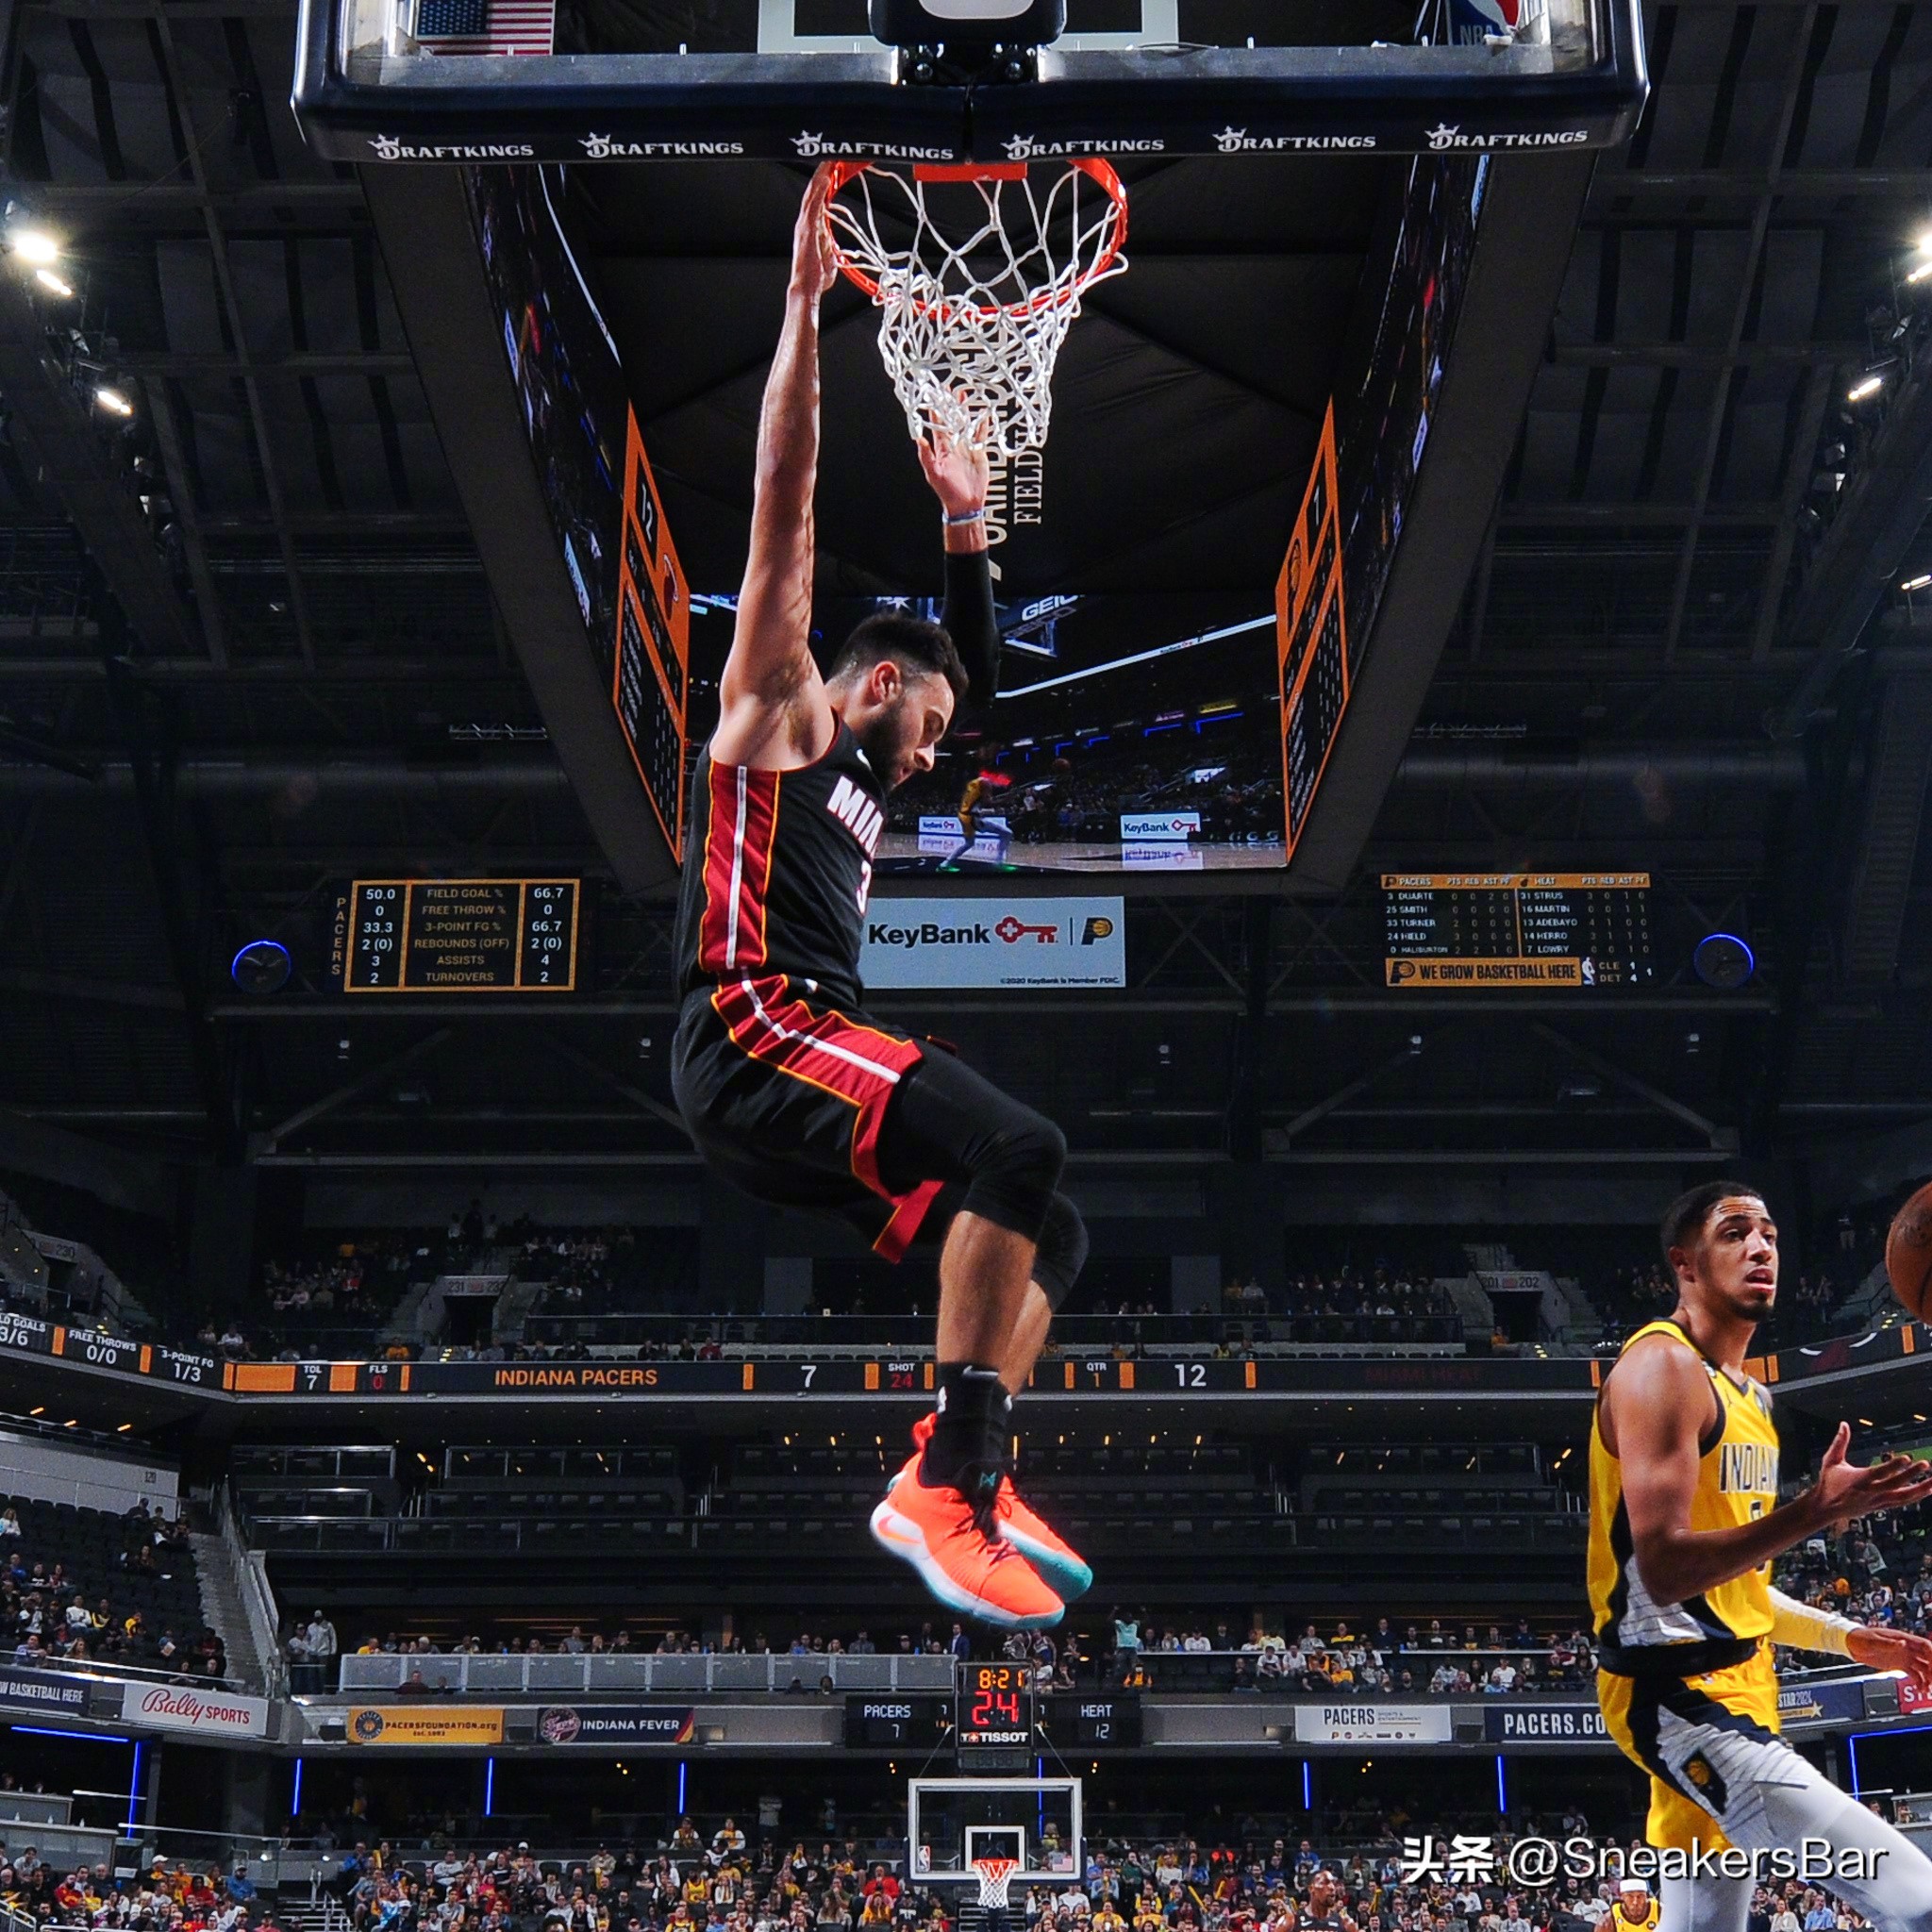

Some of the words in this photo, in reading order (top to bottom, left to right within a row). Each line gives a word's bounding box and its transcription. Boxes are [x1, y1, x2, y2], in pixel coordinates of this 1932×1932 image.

[1217, 134, 1376, 152] DRAFTKINGS
[1429, 130, 1589, 149] DRAFTKINGS
[375, 141, 534, 159] DRAFTKINGS
[586, 141, 744, 158] DRAFTKINGS
[796, 138, 954, 159] DRAFTKINGS
[1007, 139, 1164, 159] DRAFTKINGS
[827, 775, 884, 857] MIA
[1124, 823, 1169, 834] KeyBank
[366, 889, 395, 900] 50.0
[427, 889, 458, 898] FIELD
[461, 888, 491, 898] GOAL
[533, 887, 564, 899] 66.7
[1534, 891, 1563, 900] STRUS
[375, 906, 384, 916] 0
[422, 906, 449, 915] FREE
[453, 905, 495, 915] THROW
[543, 904, 553, 915] 0
[363, 922, 393, 933] 33.3
[425, 922, 471, 932] 3-POINT
[474, 922, 490, 932] FG
[531, 921, 562, 932] 66.7
[868, 924, 991, 948] KeyBank
[361, 940, 372, 951] 2
[374, 939, 393, 952] (0)
[414, 939, 477, 949] REBOUNDS
[479, 938, 509, 950] (OFF)
[530, 939, 541, 949] 2
[543, 938, 562, 951] (0)
[371, 956, 380, 967] 3
[436, 955, 485, 965] ASSISTS
[541, 954, 550, 966] 4
[1599, 961, 1621, 971] CLE
[370, 972, 379, 984] 2
[425, 972, 494, 982] TURNOVERS
[541, 972, 550, 983] 2
[1420, 964, 1438, 979] WE
[1441, 964, 1474, 979] GROW
[1477, 963, 1546, 979] BASKETBALL
[1548, 963, 1576, 979] HERE
[69, 1329, 93, 1342] FREE
[96, 1334, 137, 1352] THROWS
[86, 1346, 117, 1365] 0/0
[161, 1350, 199, 1364] 3-POINT
[201, 1358, 214, 1368] FG
[174, 1362, 201, 1383] 1/3
[304, 1366, 322, 1374] TOL
[369, 1365, 388, 1374] FLS
[888, 1362, 915, 1373] SHOT
[1087, 1362, 1107, 1374] QTR
[307, 1374, 318, 1391] 7
[494, 1370, 576, 1387] INDIANA
[581, 1369, 658, 1386] PACERS
[800, 1365, 817, 1388] 7
[891, 1373, 914, 1388] 24
[1092, 1373, 1102, 1388] 1
[1174, 1364, 1208, 1388] 12
[9, 1682, 60, 1701] BASKETBALL
[61, 1689, 84, 1704] HERE
[142, 1689, 205, 1724] Bally
[206, 1706, 251, 1724] SPORTS
[863, 1705, 911, 1718] PACERS
[972, 1690, 1020, 1725] 24
[1081, 1704, 1112, 1717] HEAT
[582, 1720, 636, 1730] INDIANA
[639, 1719, 680, 1730] FEVER
[1324, 1708, 1375, 1725] PACERS
[979, 1732, 1028, 1742] TISSOT
